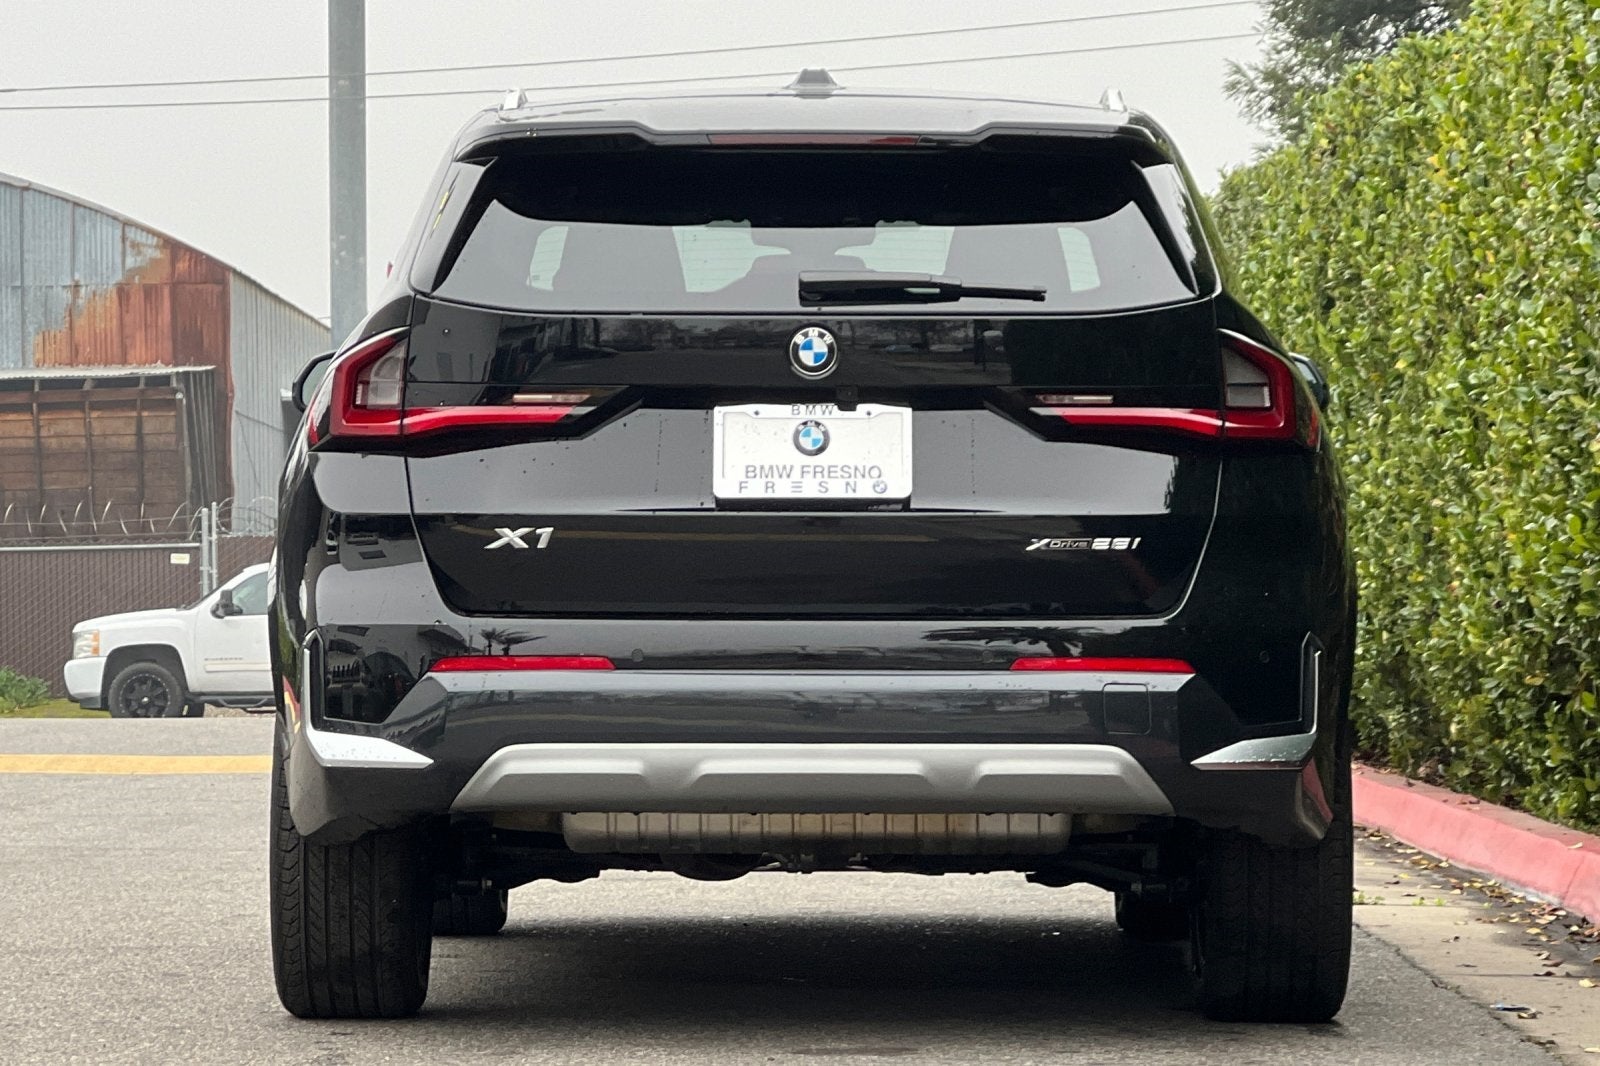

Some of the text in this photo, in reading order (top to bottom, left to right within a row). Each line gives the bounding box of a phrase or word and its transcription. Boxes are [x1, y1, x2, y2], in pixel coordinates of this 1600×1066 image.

[794, 328, 834, 345] BMW
[791, 404, 835, 416] BMW
[745, 465, 882, 479] BMW FRESNO
[484, 526, 554, 549] X1
